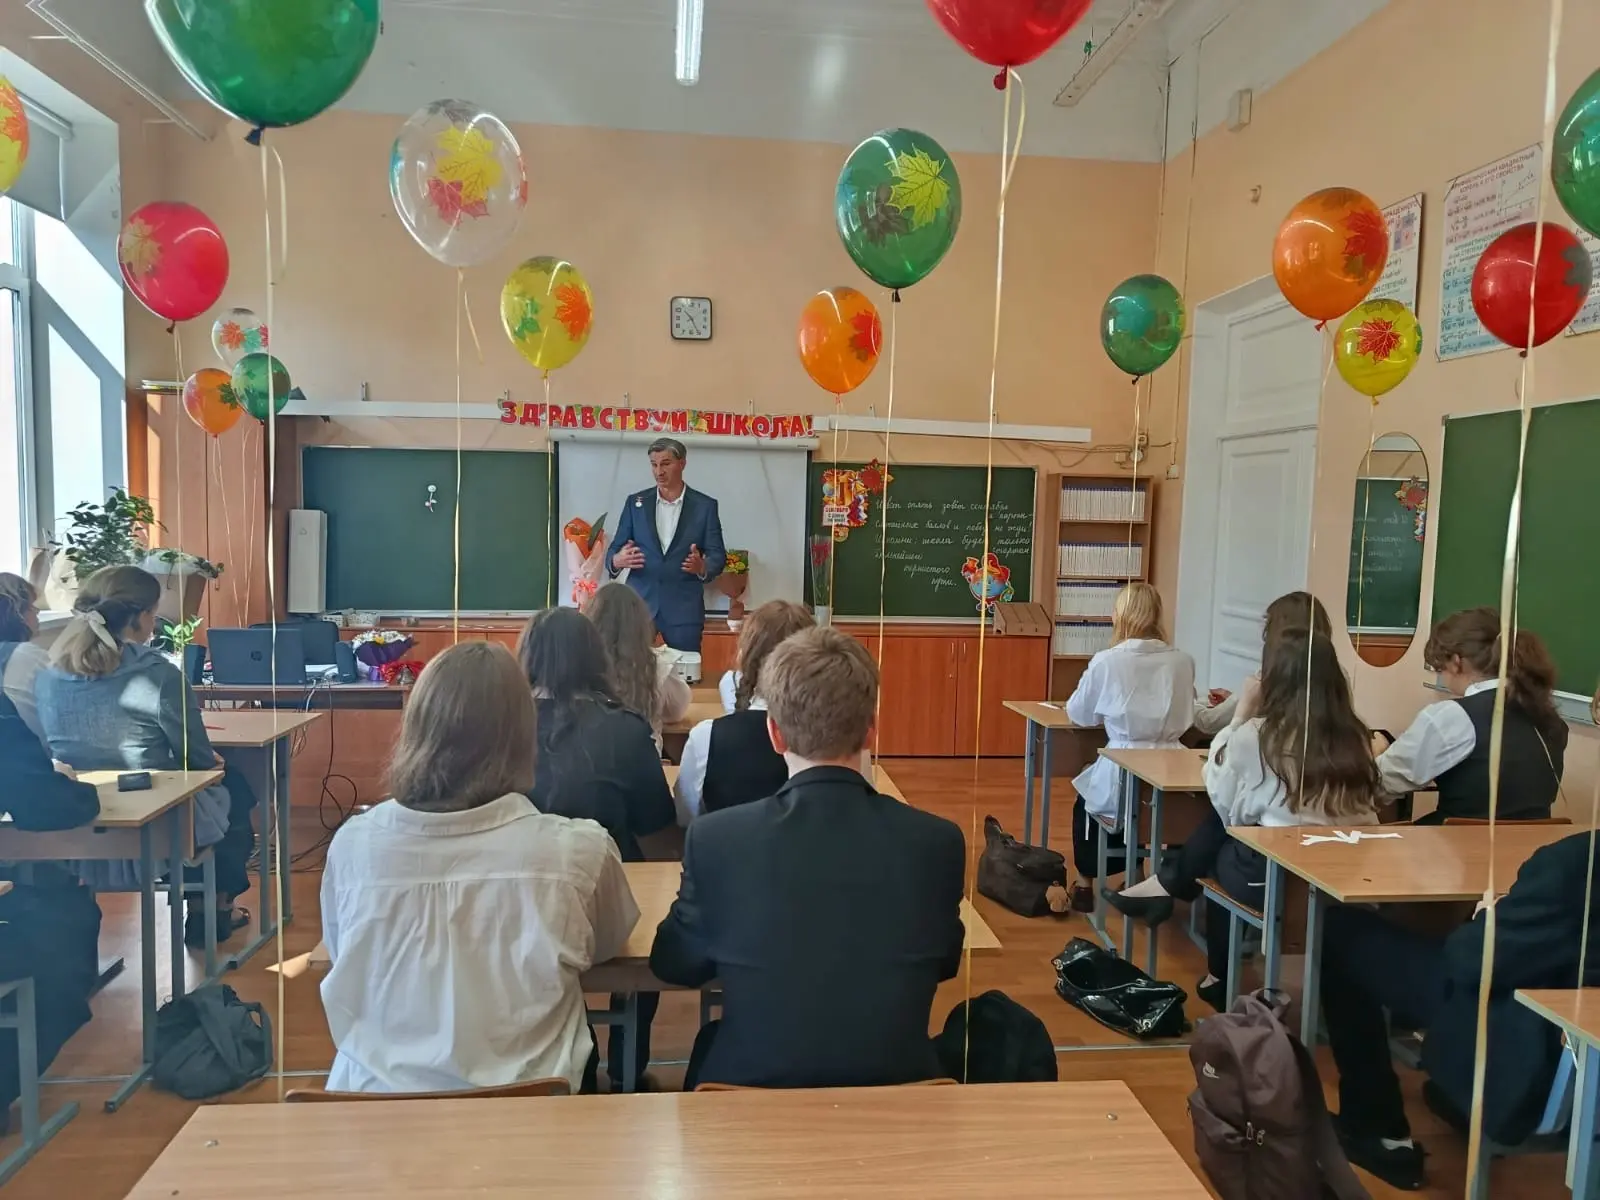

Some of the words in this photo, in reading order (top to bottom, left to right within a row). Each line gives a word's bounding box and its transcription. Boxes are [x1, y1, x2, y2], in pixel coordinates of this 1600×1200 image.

[706, 411, 816, 439] ШКОЛА!
[970, 501, 1008, 510] сенябрь
[922, 536, 953, 545] школа
[931, 577, 957, 592] пути.
